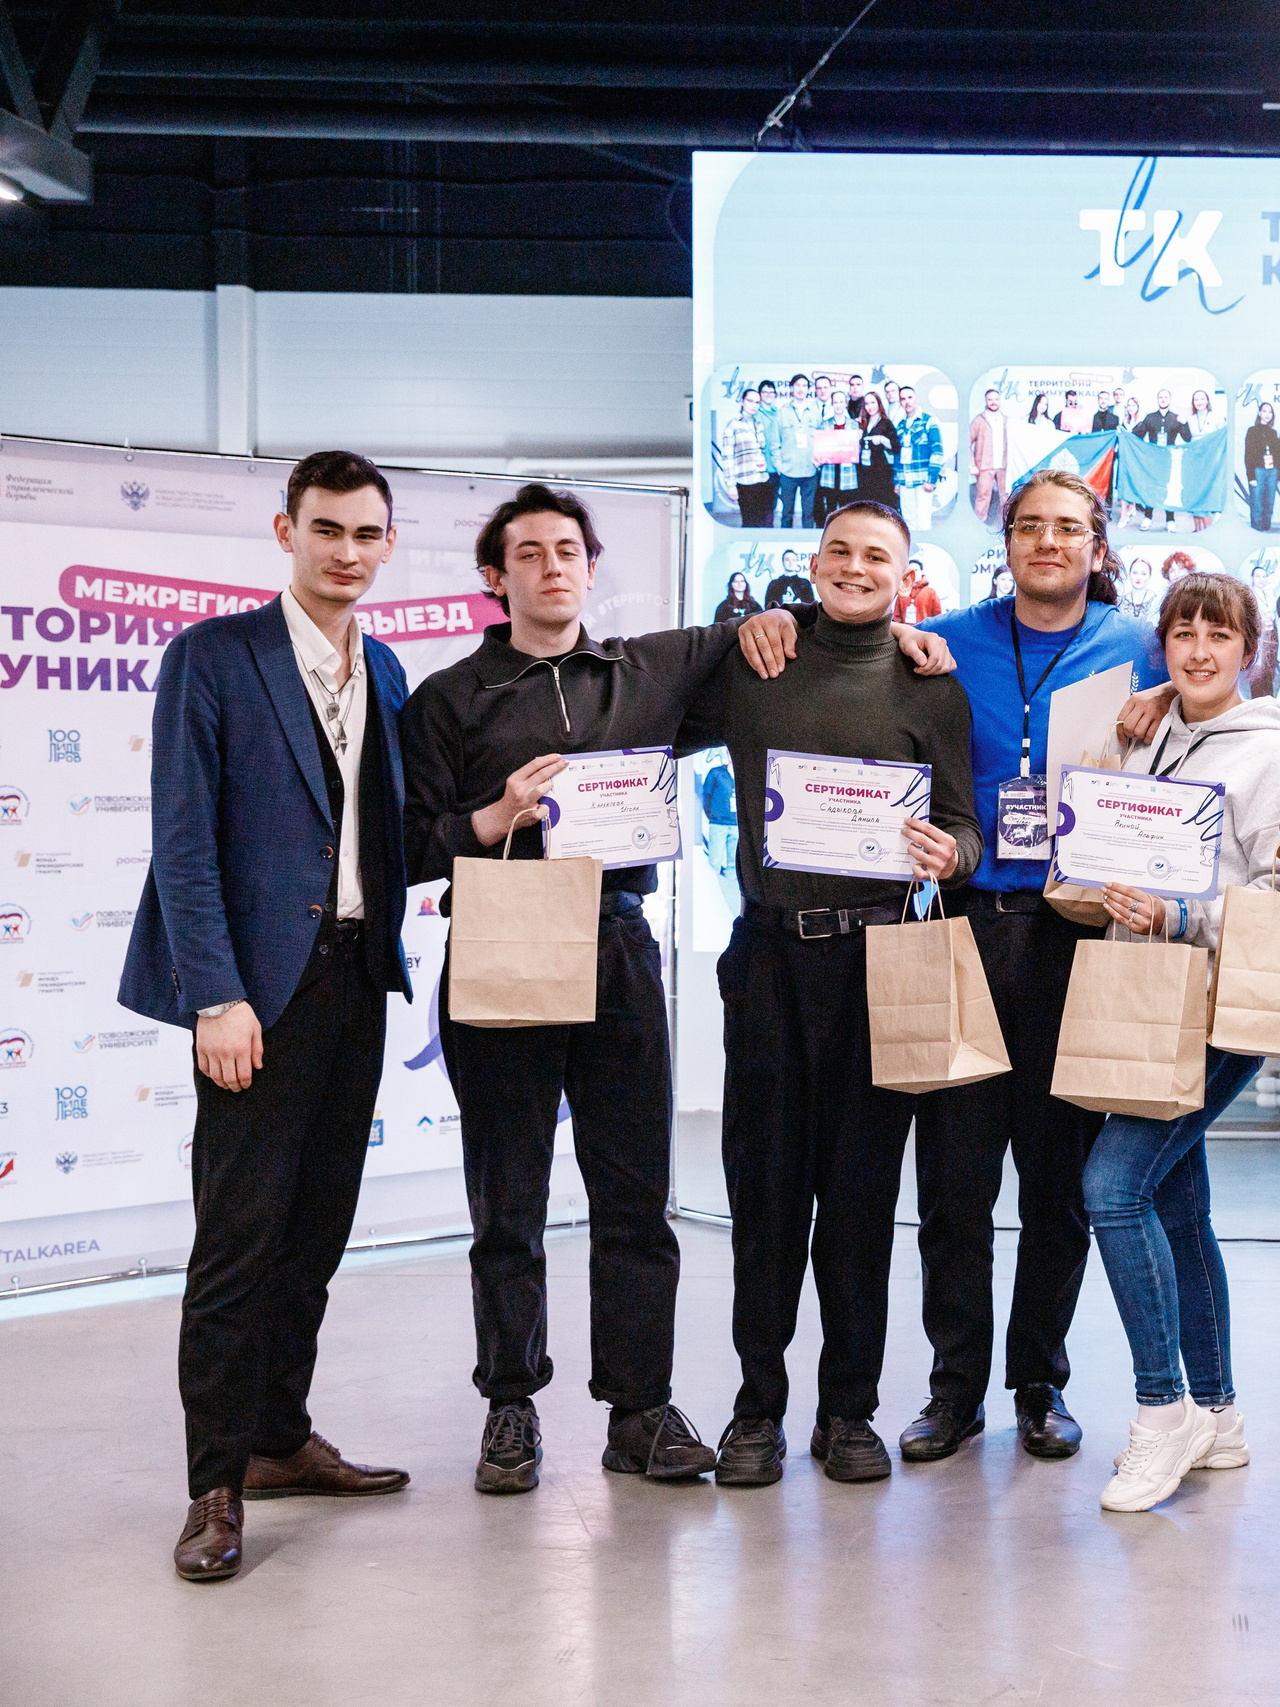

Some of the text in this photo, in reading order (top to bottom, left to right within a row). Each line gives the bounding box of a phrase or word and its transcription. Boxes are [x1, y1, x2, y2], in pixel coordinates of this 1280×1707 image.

[74, 575, 272, 616] МЕЖРЕГИО
[577, 777, 649, 793] СЕРТИФИКАТ
[805, 783, 891, 800] СЕРТИФИКАТ
[829, 797, 861, 805] УЧАСТНИКА
[1097, 798, 1183, 818] СЕРТИФИКАТ
[1119, 813, 1152, 822] УЧАСТНИКА
